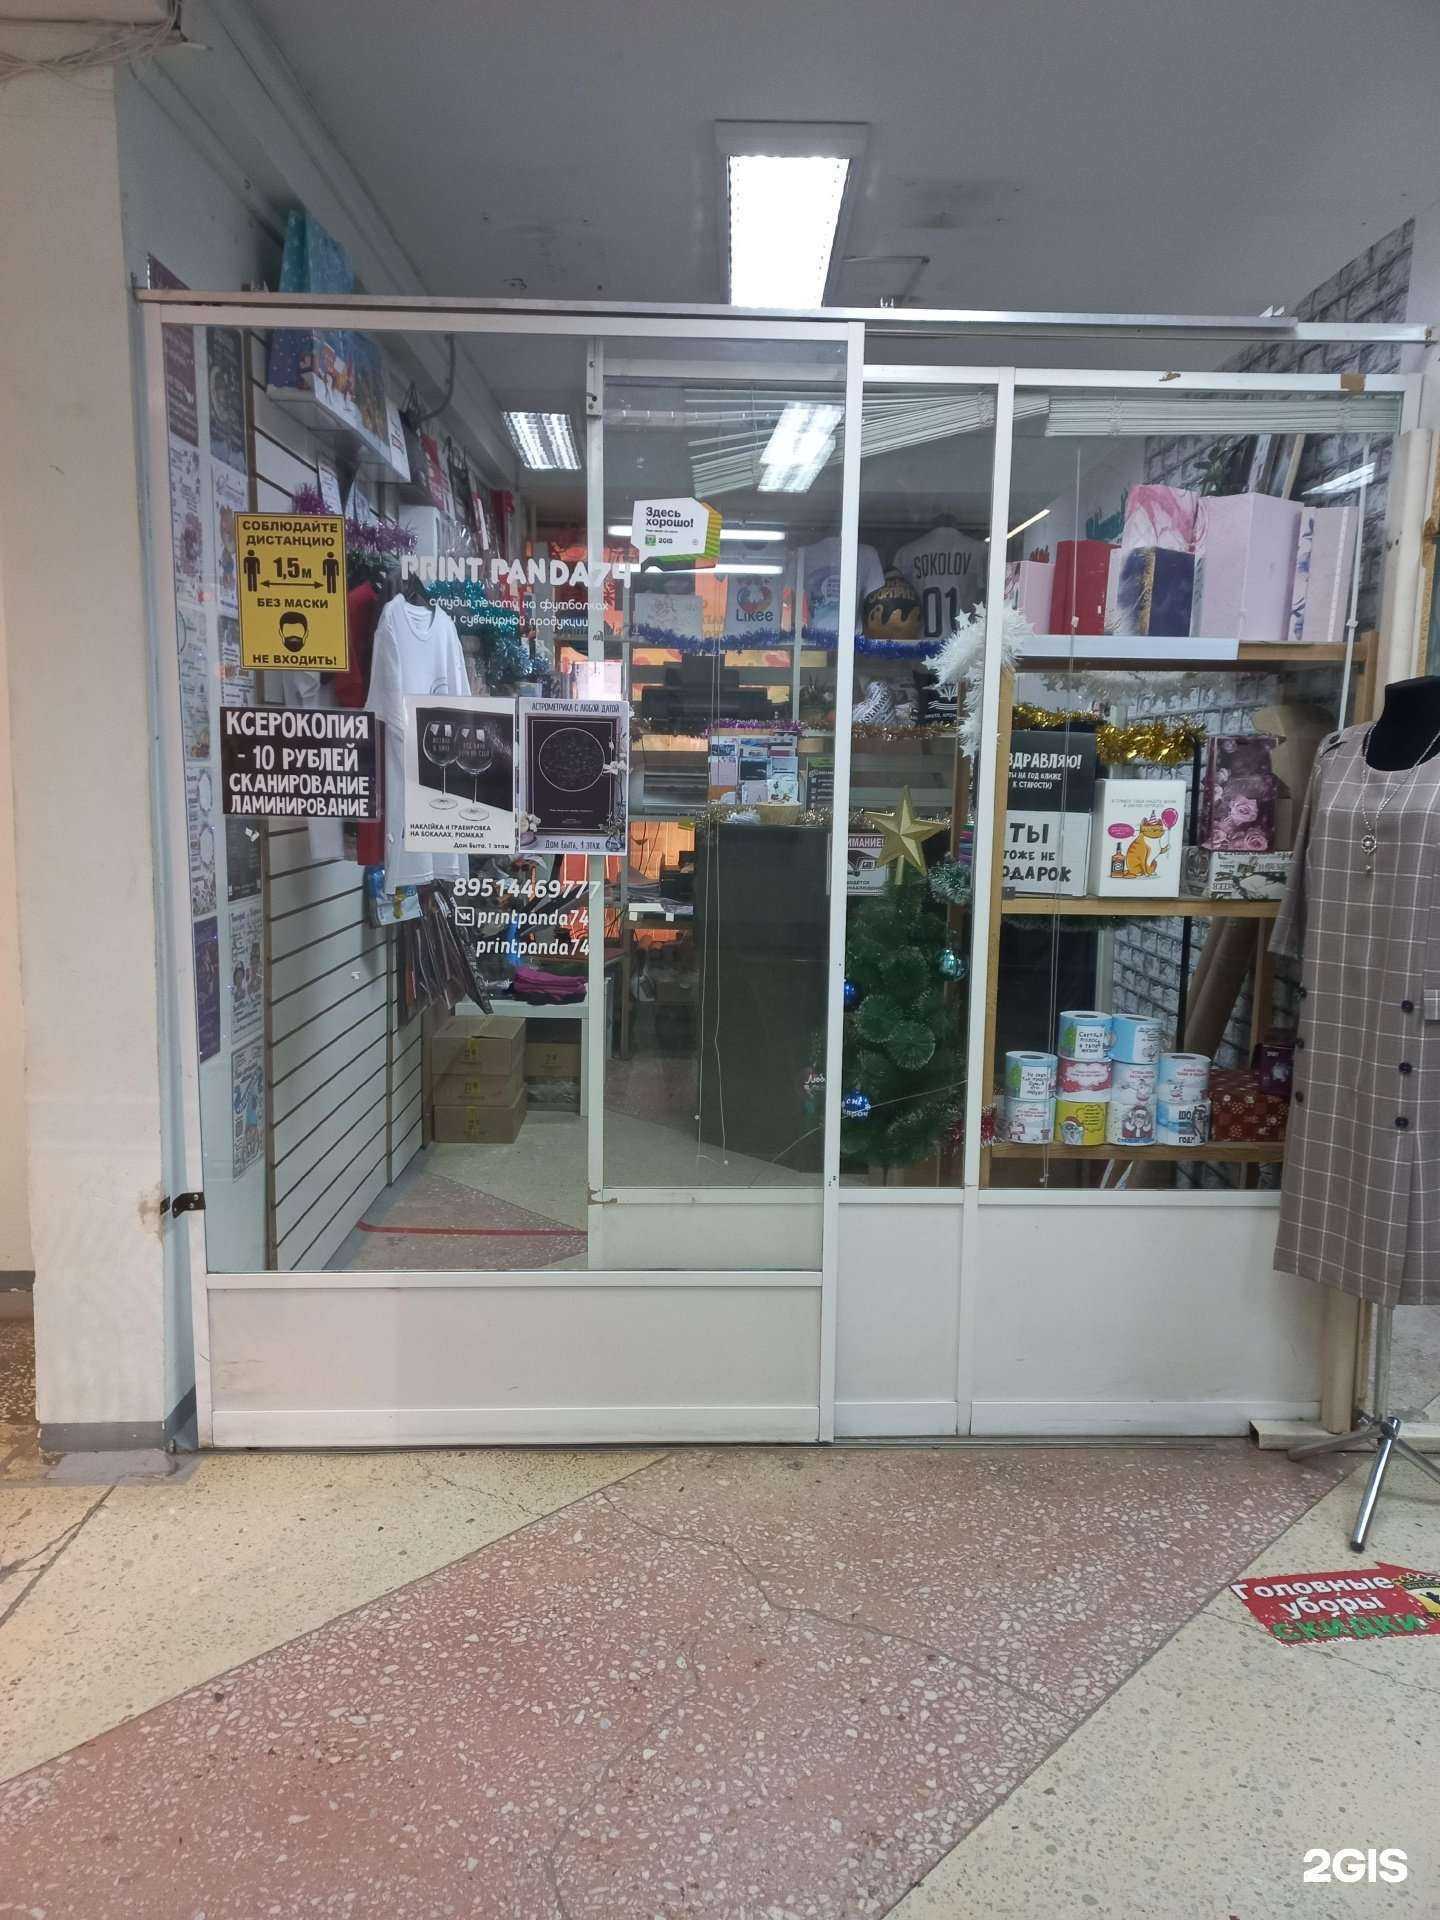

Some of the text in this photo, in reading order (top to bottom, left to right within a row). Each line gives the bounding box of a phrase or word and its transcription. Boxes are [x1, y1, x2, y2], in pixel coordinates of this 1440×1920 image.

[646, 506, 681, 518] Здесь
[242, 520, 338, 534] СОБЛЮДАЙТЕ
[646, 518, 694, 528] хорошо!
[246, 535, 335, 549] ДИСТАНЦИЮ
[401, 555, 631, 589] PRINT PANDA74
[913, 552, 972, 579] SOKOLOV
[257, 598, 329, 609] БЕЗ МАСКИ
[736, 608, 774, 622] Likee
[252, 654, 337, 666] НЕ ВХОДИТЬ!
[226, 711, 369, 740] КСЕРОКОПИЯ
[252, 744, 275, 770] 10
[282, 742, 359, 772] РУБЛЕЙ
[1008, 752, 1082, 770] ЗДРАВЛЯЮ!
[229, 773, 370, 796] СКАНИРОВАНИЕ
[230, 794, 369, 817] ЛАМИНИРОВАНИЕ
[848, 837, 884, 848] ИМАНИЕ!
[1009, 822, 1050, 844] ТЫ
[1003, 850, 1056, 861] ТОЖЕ НЕ
[1002, 865, 1072, 882] ОДАРОК
[453, 878, 602, 899] 89514469777
[477, 908, 590, 928] printpanda74
[476, 938, 590, 958] printpanda74
[1229, 1576, 1395, 1600] Головные
[1280, 1596, 1386, 1620] уборы
